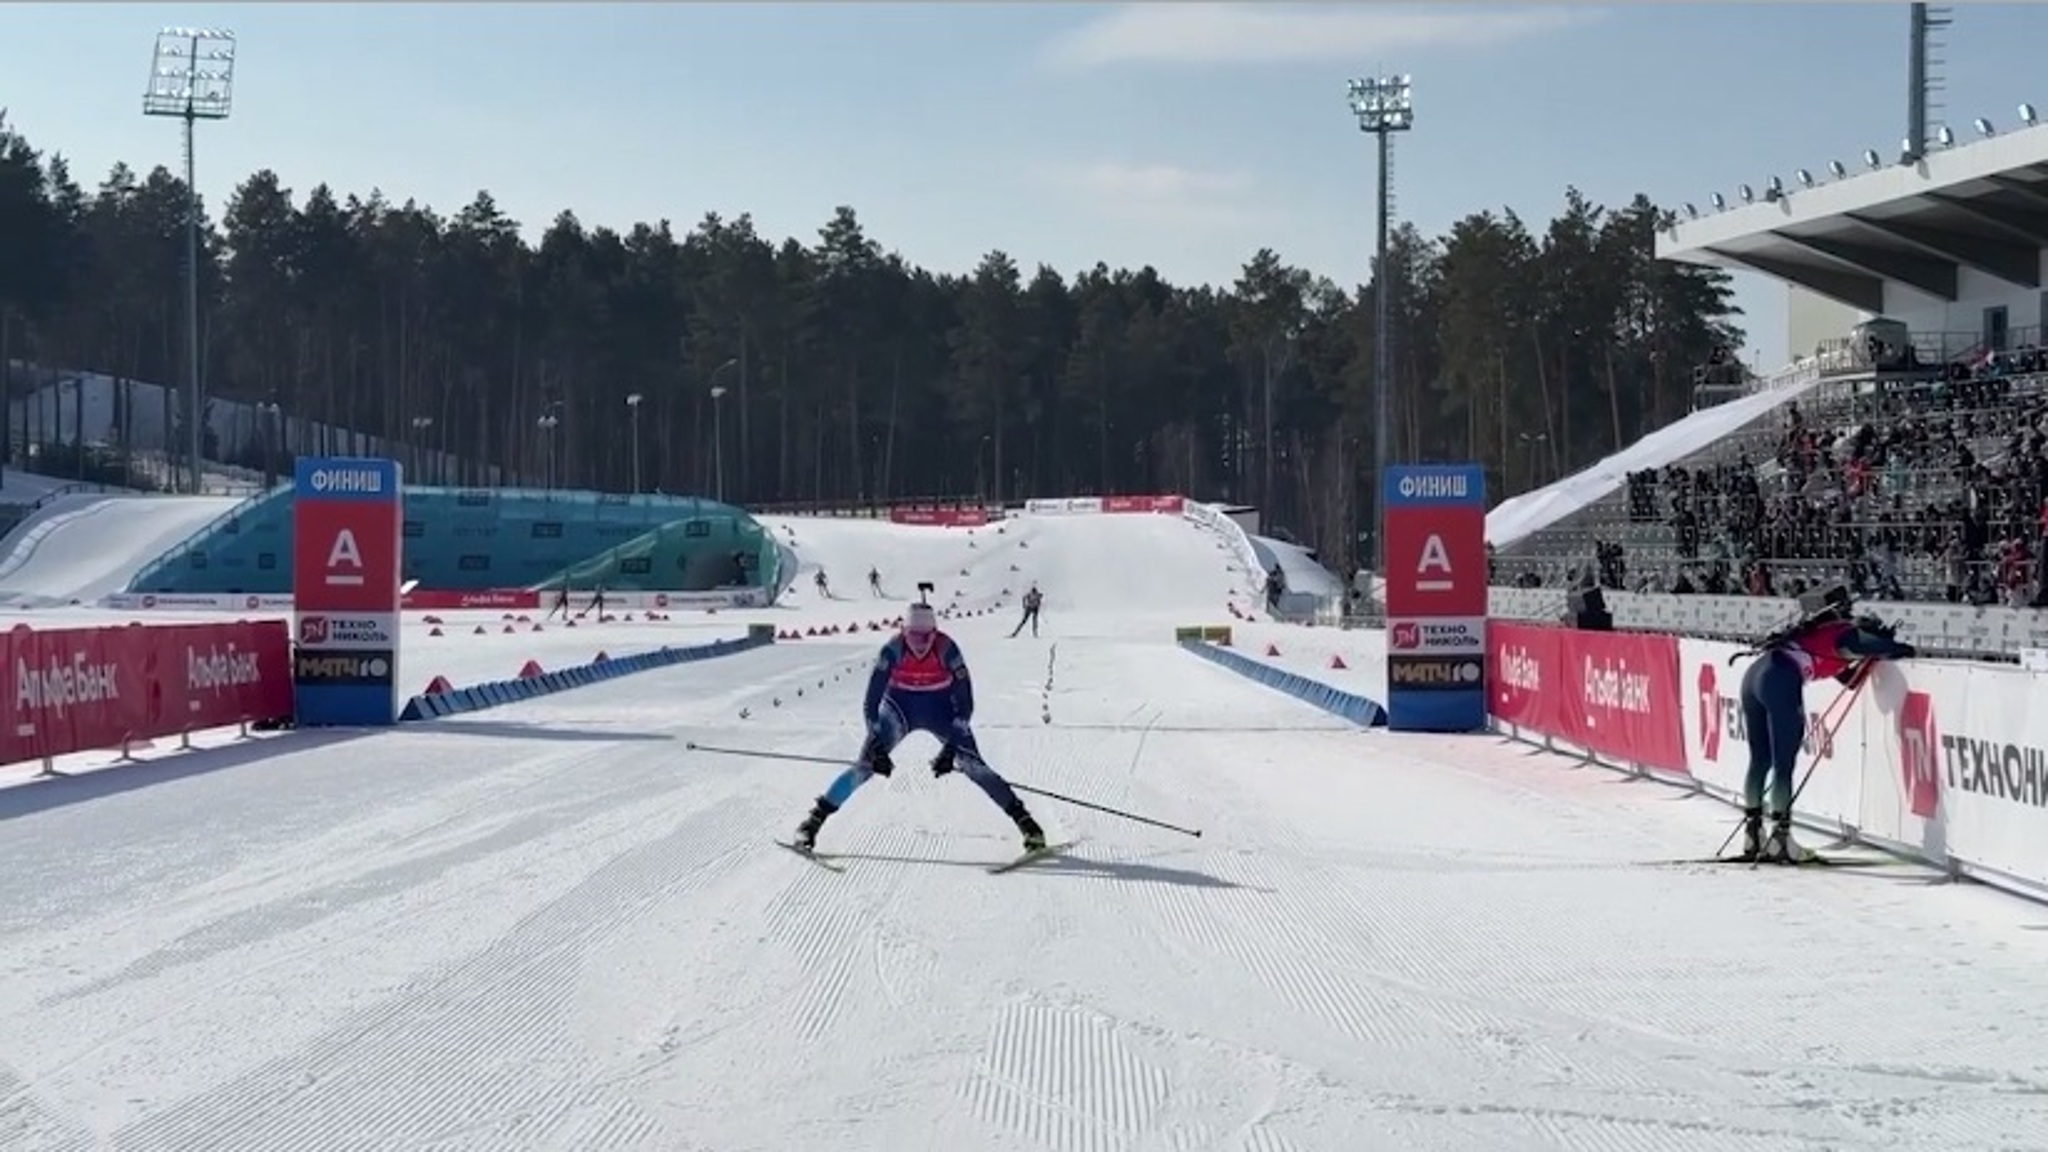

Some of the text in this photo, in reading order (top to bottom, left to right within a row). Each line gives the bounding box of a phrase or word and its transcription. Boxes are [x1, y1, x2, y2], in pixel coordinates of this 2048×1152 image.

[310, 469, 382, 492] ФИНИШ
[1399, 475, 1467, 498] ФИНИШ
[331, 620, 377, 630] ТЕХНО
[1423, 624, 1467, 634] ТЕХНО
